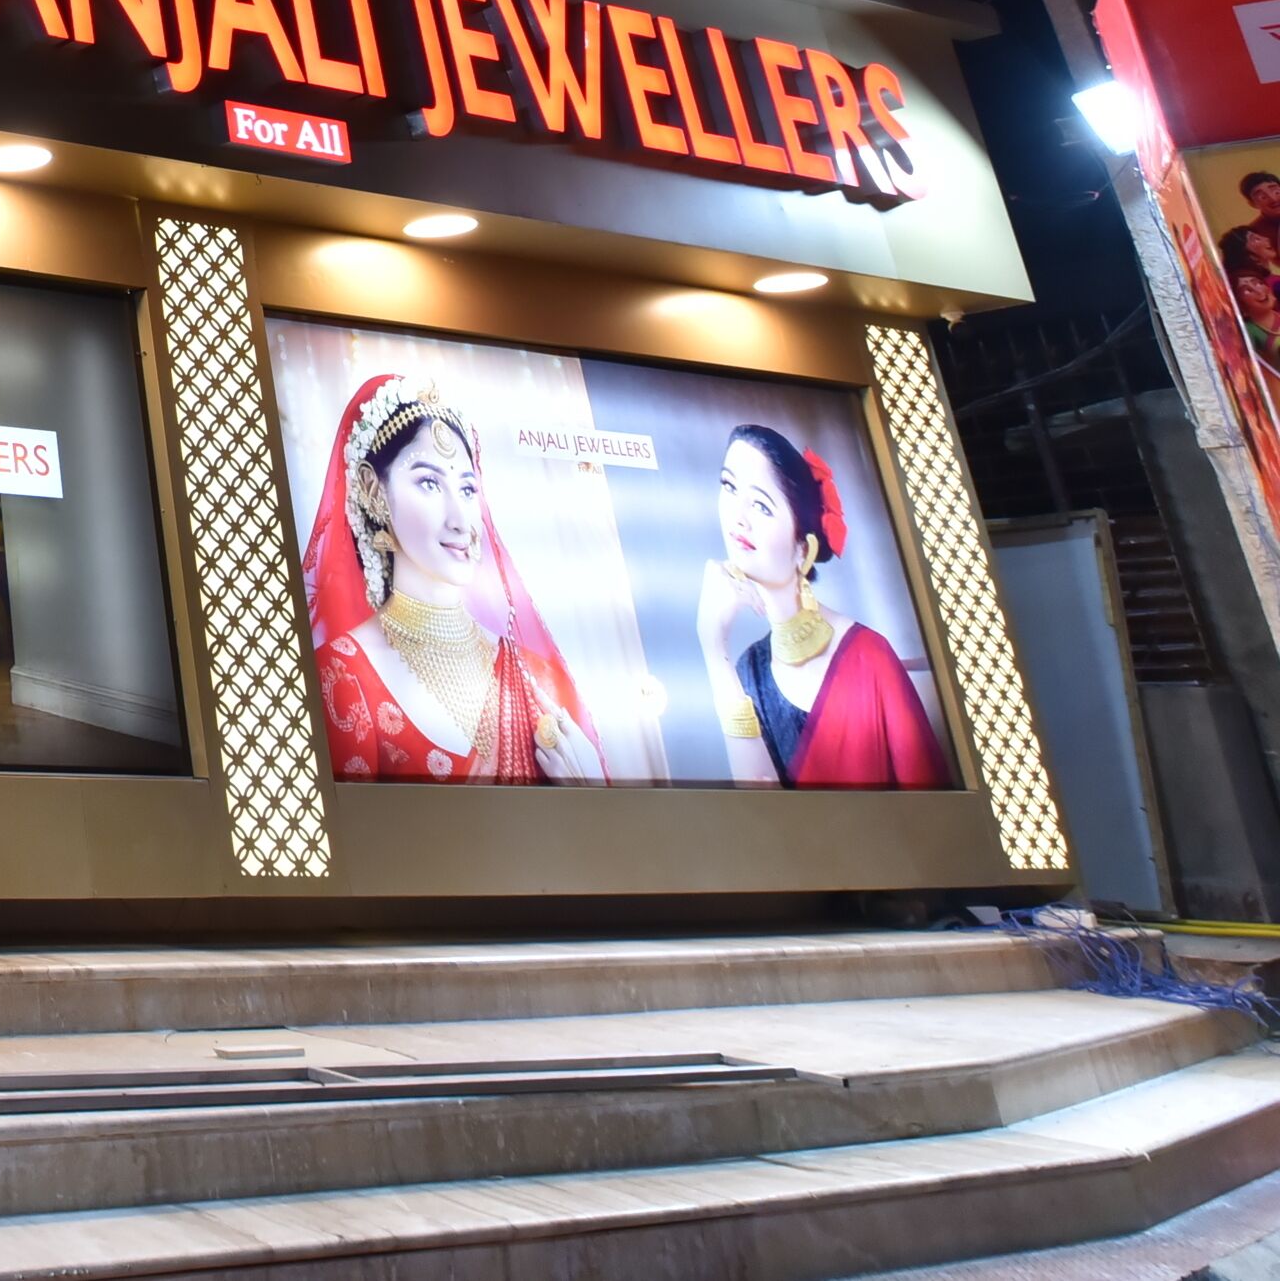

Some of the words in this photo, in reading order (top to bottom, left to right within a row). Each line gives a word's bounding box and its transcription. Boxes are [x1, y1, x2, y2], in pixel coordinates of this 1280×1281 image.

[233, 107, 289, 146] For
[296, 120, 344, 156] All
[518, 429, 569, 453] ANJALI
[573, 435, 652, 460] JEWELLERS
